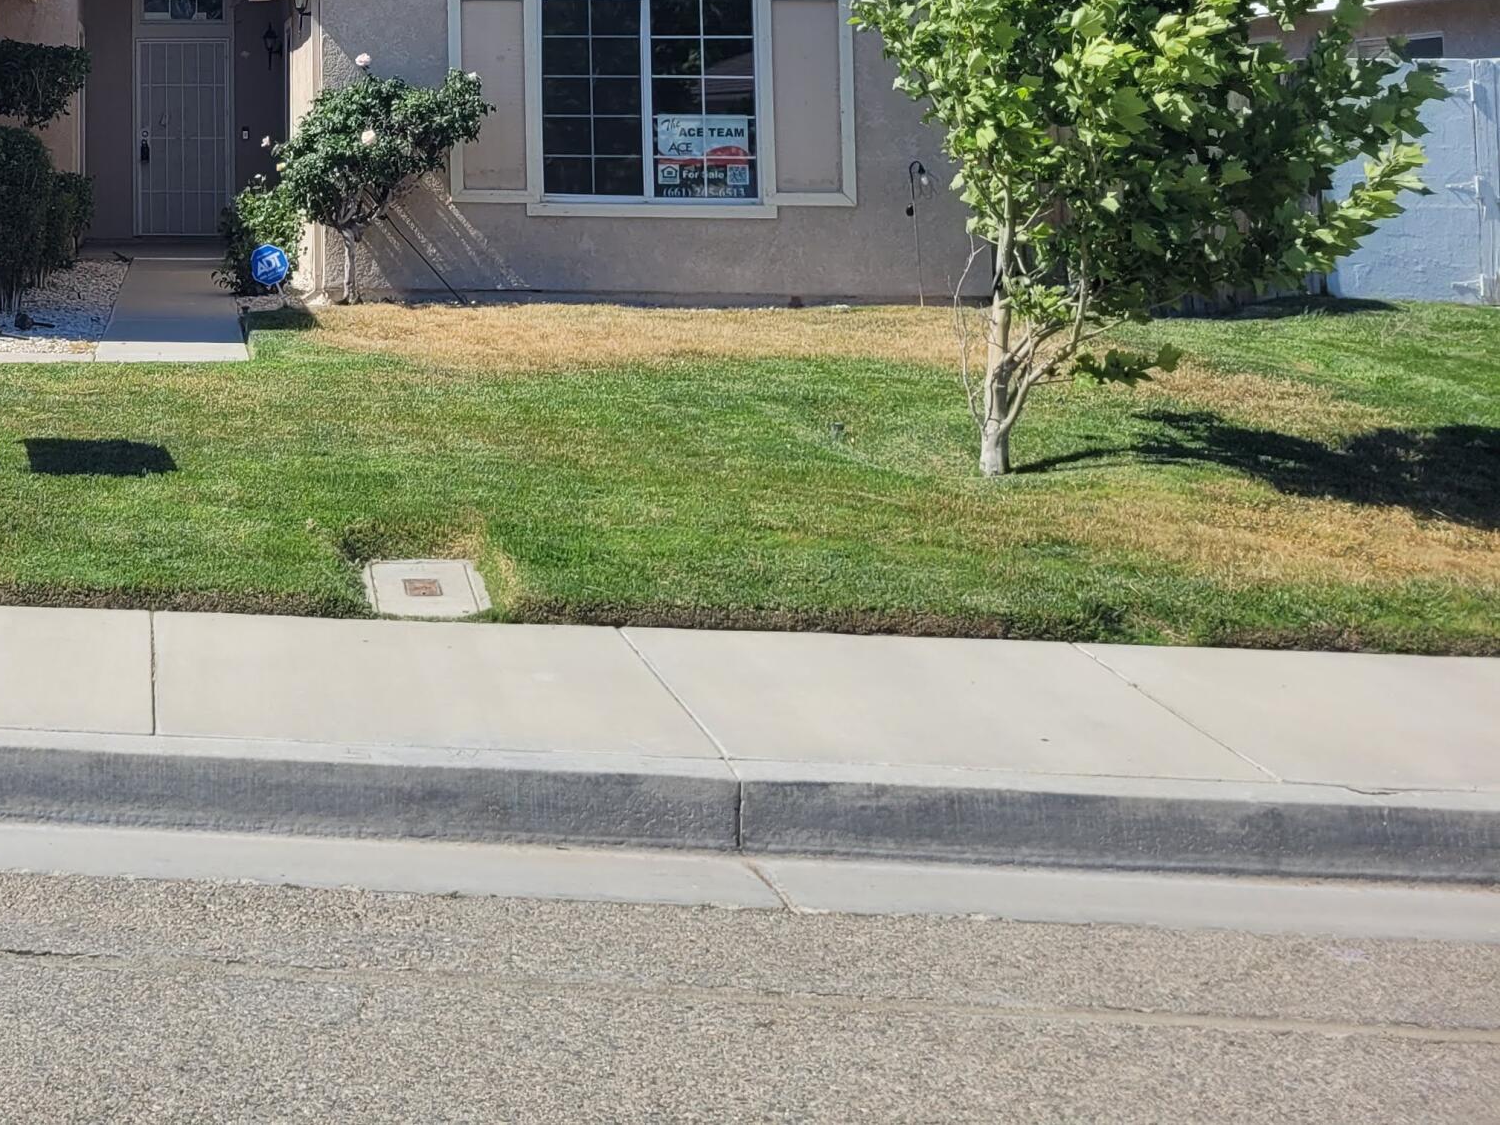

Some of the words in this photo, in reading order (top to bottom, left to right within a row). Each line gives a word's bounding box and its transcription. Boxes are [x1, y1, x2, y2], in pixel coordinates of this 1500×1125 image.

[661, 117, 680, 131] The
[679, 127, 704, 137] ACE
[708, 127, 744, 137] TEAM
[668, 142, 693, 155] ACE
[682, 170, 700, 179] For
[663, 187, 691, 197] (661)
[257, 252, 281, 277] ADT
